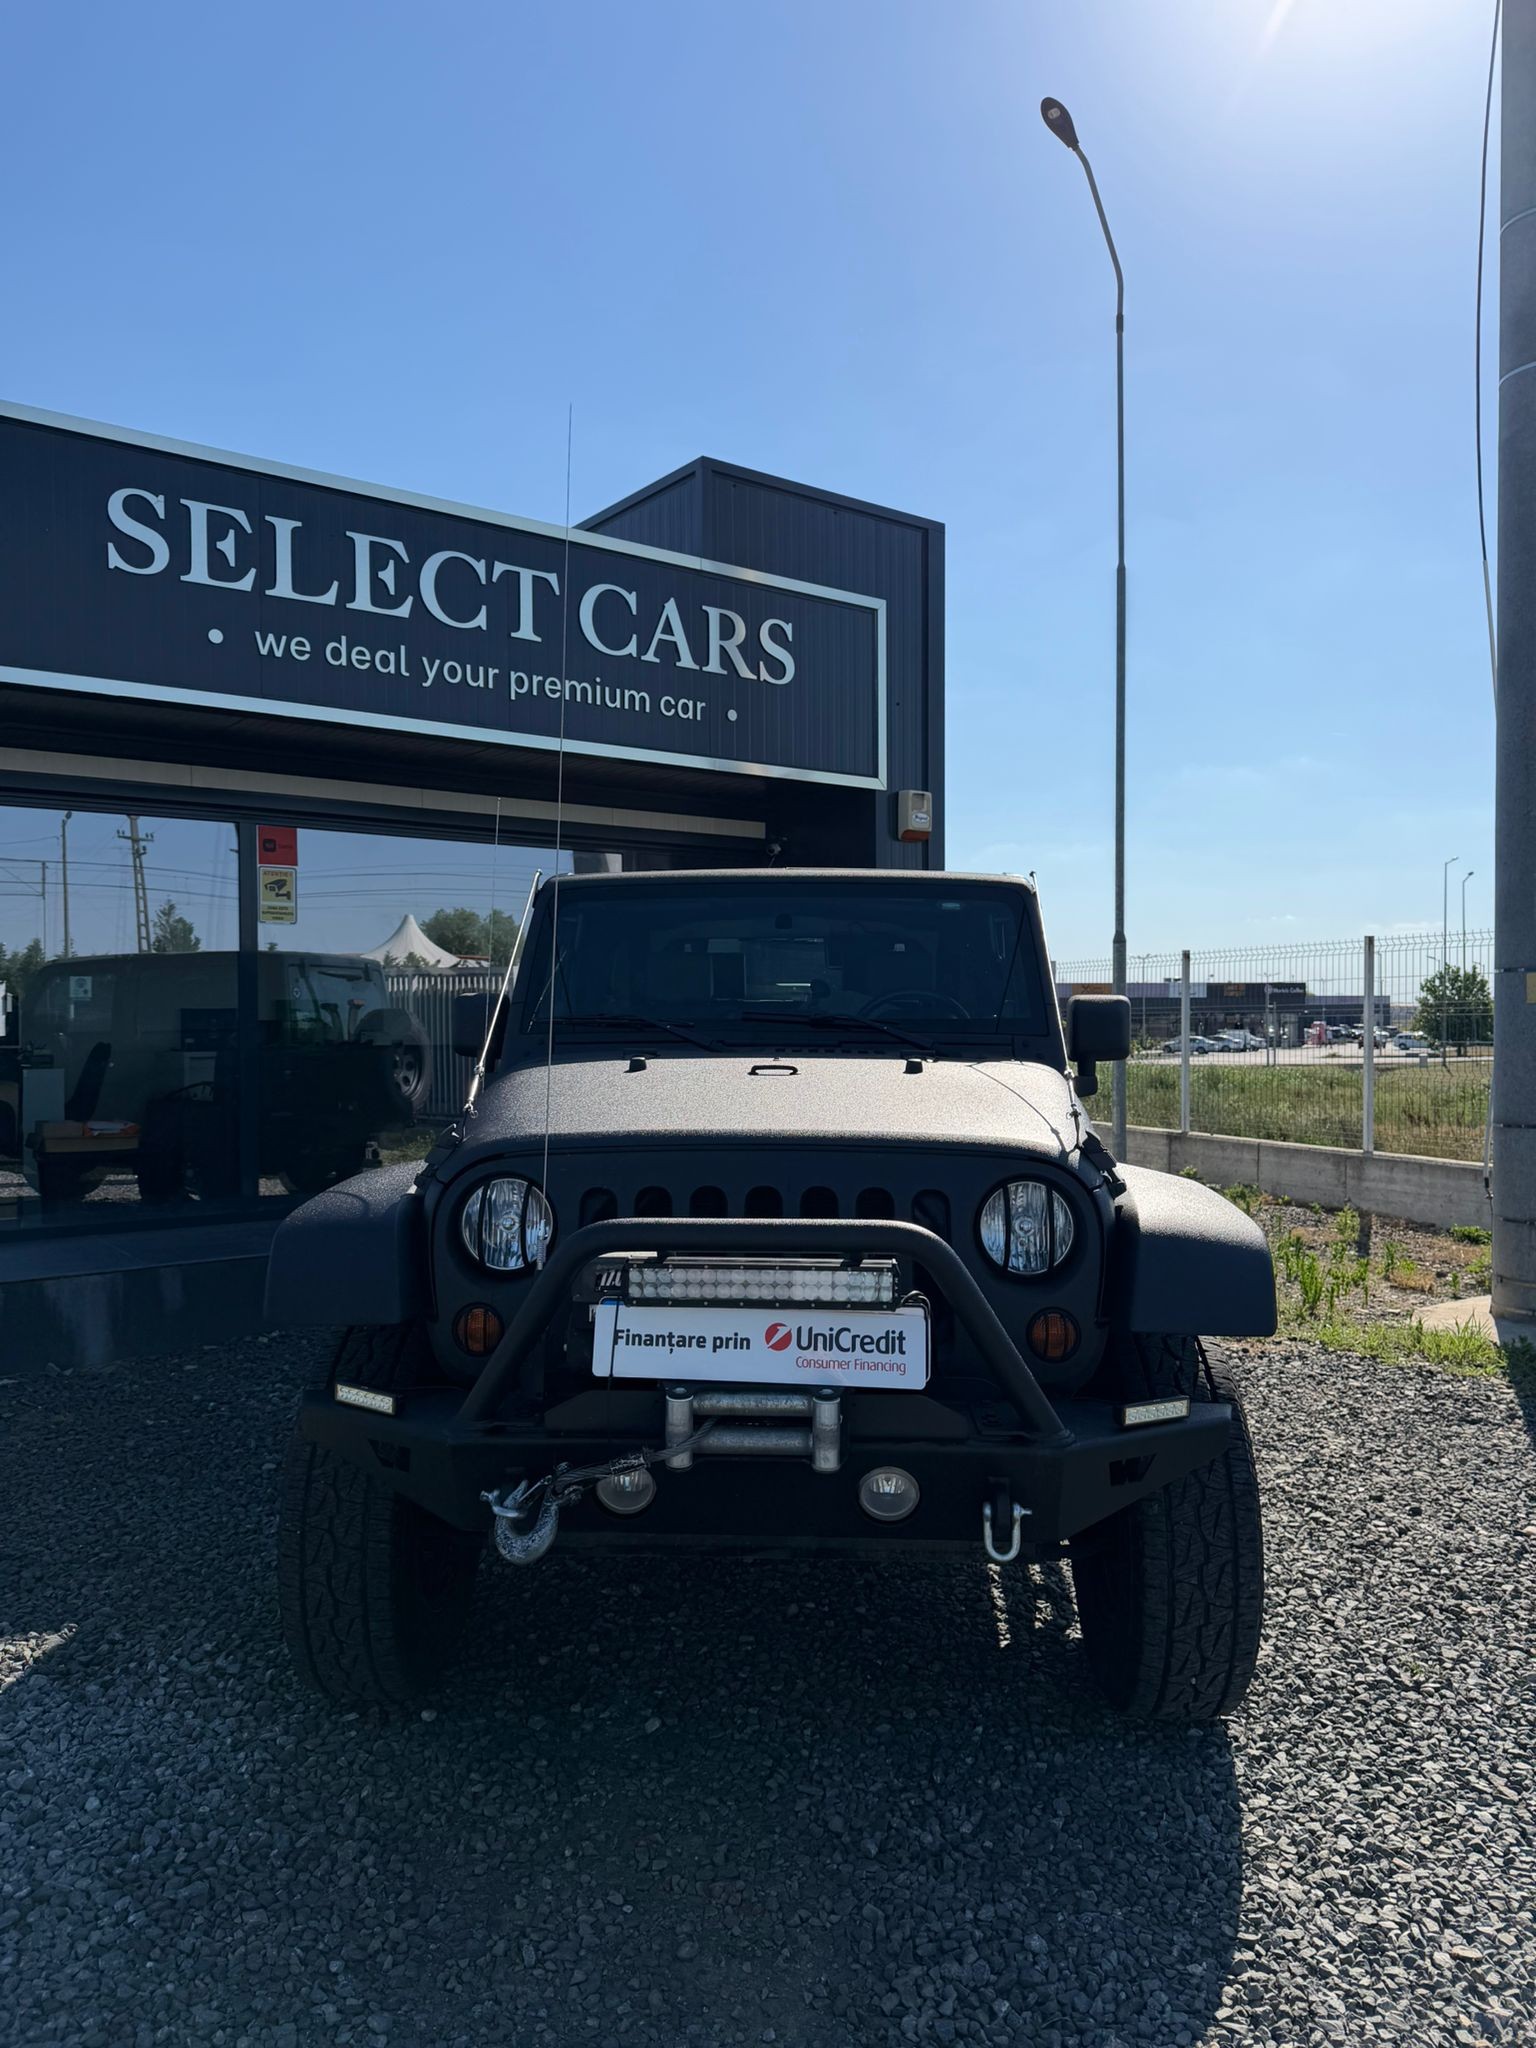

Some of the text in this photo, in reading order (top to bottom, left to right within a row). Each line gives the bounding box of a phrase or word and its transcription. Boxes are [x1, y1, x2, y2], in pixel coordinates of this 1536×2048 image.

[107, 487, 796, 685] SELECT CARS
[254, 631, 706, 720] we deal your premium car
[614, 1326, 906, 1355] Finanțare prin UniCredit
[796, 1356, 906, 1376] Consumer Financing
